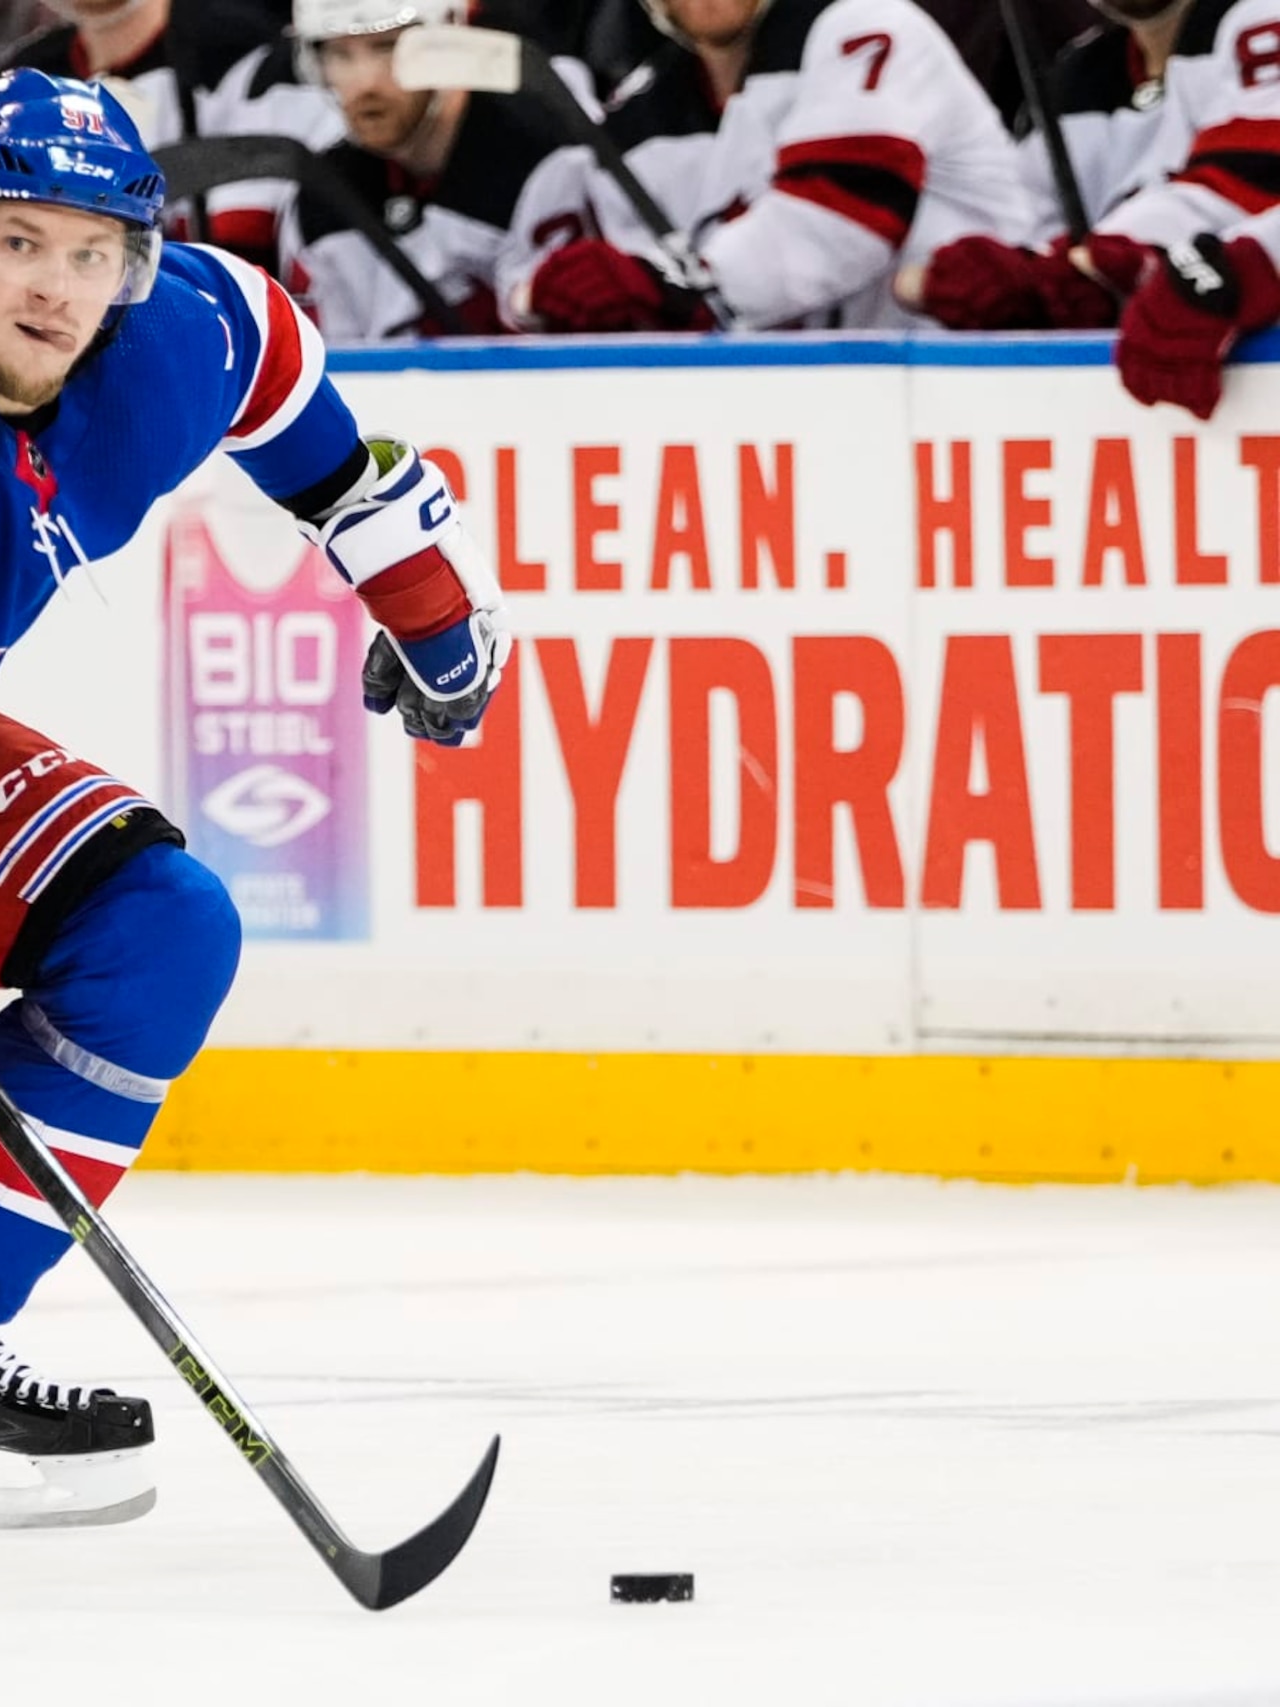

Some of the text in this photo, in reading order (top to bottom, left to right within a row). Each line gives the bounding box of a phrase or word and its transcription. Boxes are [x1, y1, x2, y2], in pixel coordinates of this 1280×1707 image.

[842, 33, 893, 91] 7
[61, 106, 104, 135] 91
[190, 612, 337, 705] BIO
[436, 652, 475, 687] CCM
[194, 711, 334, 754] STEEL
